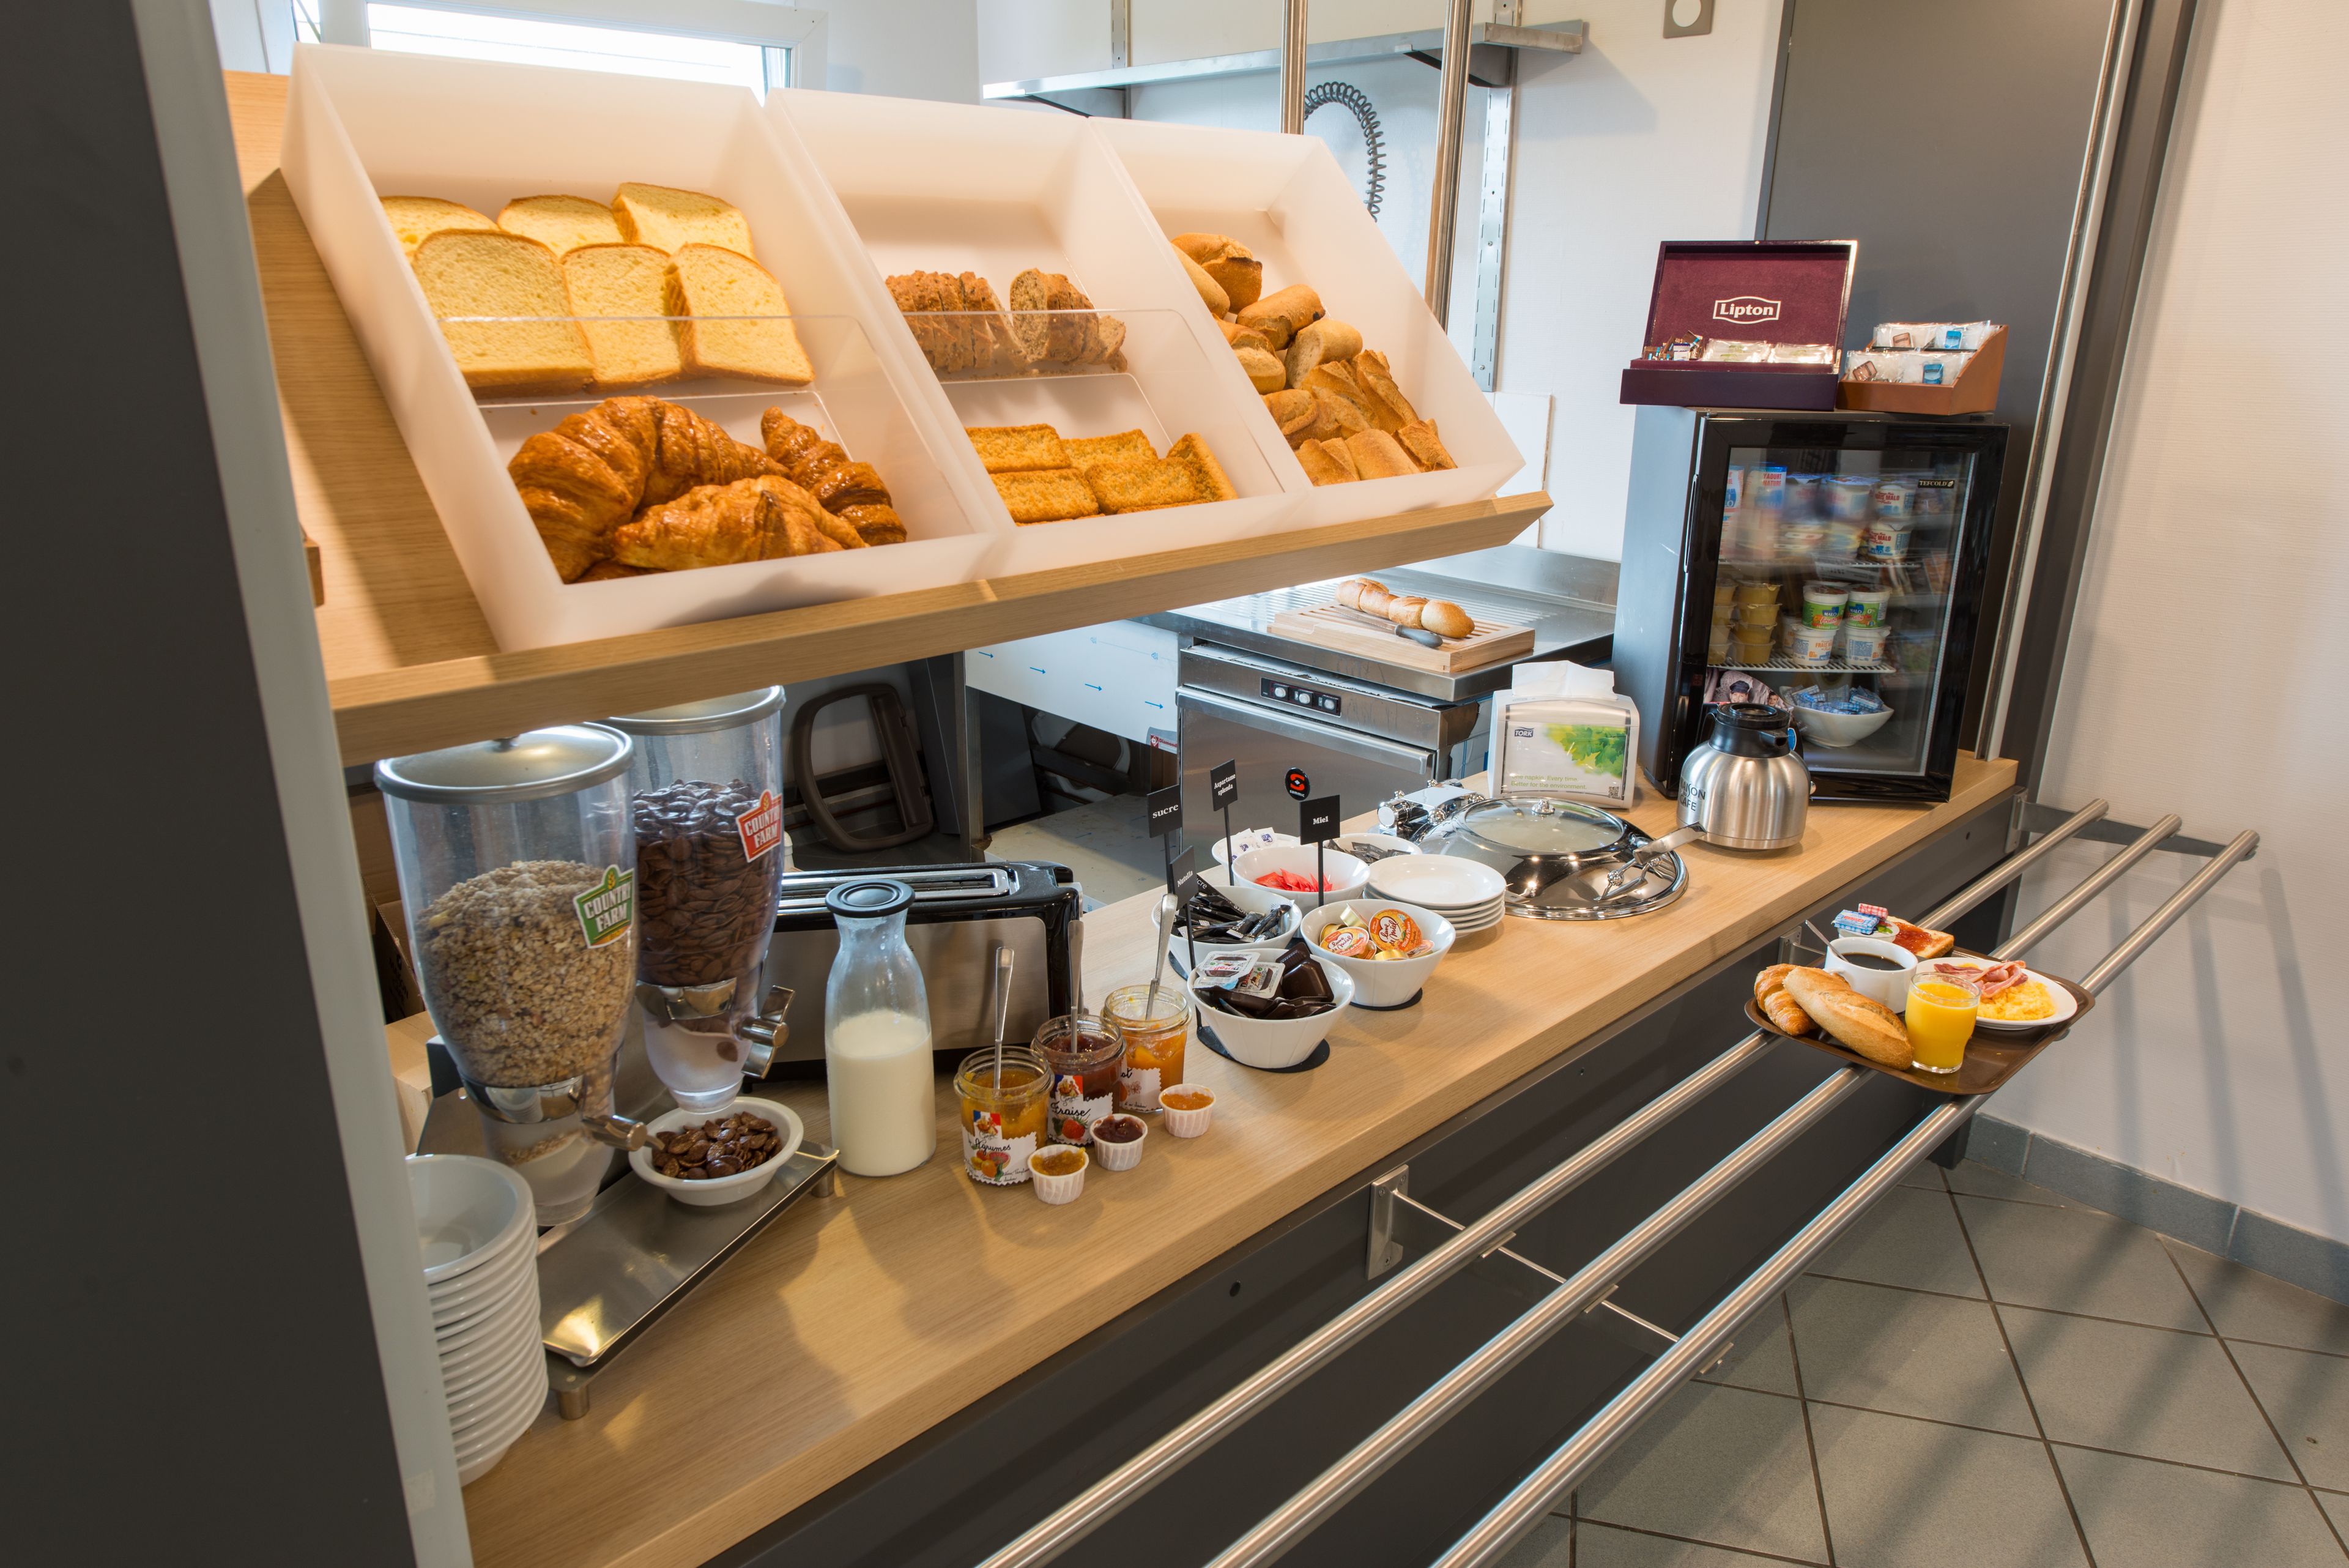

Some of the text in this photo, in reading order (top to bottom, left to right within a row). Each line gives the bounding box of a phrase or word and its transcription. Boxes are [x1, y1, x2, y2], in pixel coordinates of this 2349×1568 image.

[1720, 303, 1773, 318] Lipton
[1159, 738, 1178, 748] Diamond
[1214, 773, 1236, 789] Aspartame
[1218, 784, 1233, 796] splenda
[1152, 804, 1179, 819] sucre
[744, 805, 781, 836] COUNTRY
[1313, 816, 1329, 825] Miel
[754, 822, 777, 849] FARM
[1177, 870, 1193, 888] Nutella
[1197, 878, 1208, 890] cre
[584, 882, 631, 920] COUNTRY
[596, 902, 627, 932] FARM
[1050, 1101, 1091, 1117] Fraise
[974, 1138, 1011, 1156] Agrumes
